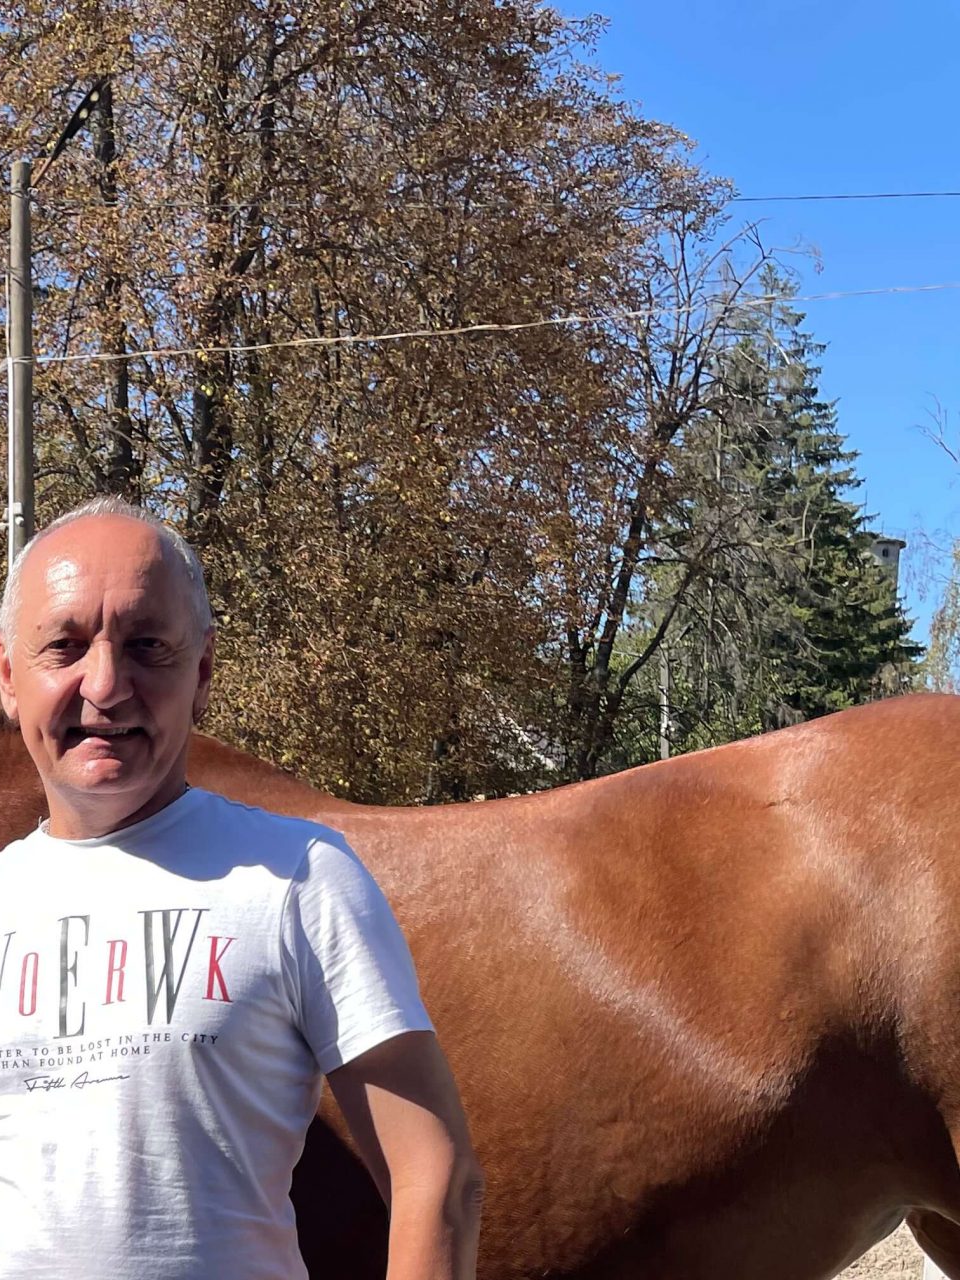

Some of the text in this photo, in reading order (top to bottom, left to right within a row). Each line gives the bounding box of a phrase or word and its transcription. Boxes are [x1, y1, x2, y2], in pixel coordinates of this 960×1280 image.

[32, 1047, 49, 1056] TO
[57, 1045, 73, 1055] BE
[80, 1038, 112, 1052] LOST
[119, 1035, 133, 1045] IN
[142, 1033, 171, 1043] THE
[181, 1033, 219, 1044] CITY
[39, 1055, 83, 1067] FOUND
[89, 1051, 104, 1062] AT
[111, 1045, 151, 1058] HOME
